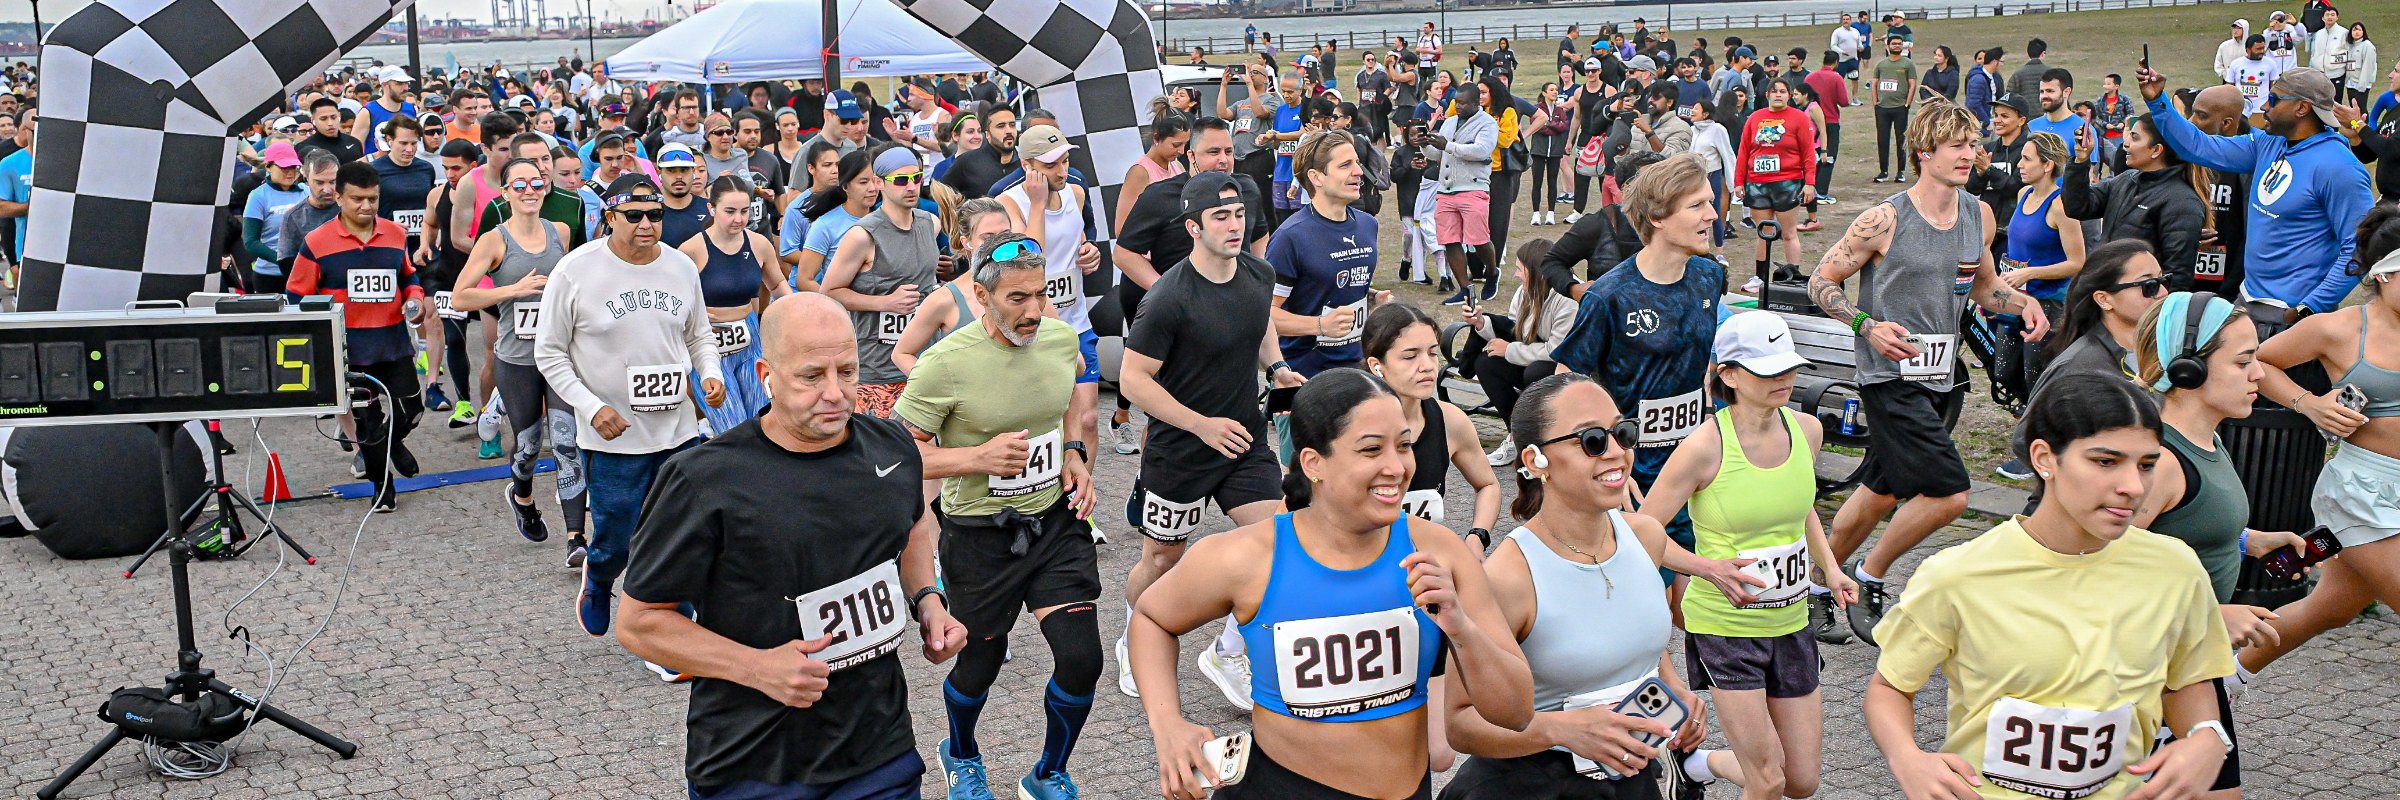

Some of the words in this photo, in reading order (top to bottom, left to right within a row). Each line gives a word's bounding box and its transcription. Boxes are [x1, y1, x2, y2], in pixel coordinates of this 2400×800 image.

[1755, 159, 1777, 171] 3451
[1351, 266, 1369, 274] NEW
[2196, 254, 2220, 273] 55
[354, 276, 391, 292] 2130
[1047, 276, 1073, 299] 391
[1351, 273, 1371, 281] YORK
[606, 289, 684, 319] LUCKY
[1769, 303, 1793, 311] PELICAN
[518, 308, 540, 328] 77
[884, 313, 916, 334] 20
[1970, 323, 1995, 355] LECTRIC
[277, 338, 311, 391] 5
[633, 372, 682, 398] 2227
[0, 404, 48, 415] hronomix
[633, 404, 667, 412] TRISTATE
[1643, 399, 1699, 434] 2388
[993, 487, 1034, 496] TRISTATE
[1035, 479, 1059, 492] TIMING
[1147, 502, 1201, 529] 2370
[818, 579, 896, 648] 2118
[828, 649, 877, 672] RISTATE
[1293, 626, 1403, 689] 2021
[1292, 703, 1361, 718] TRISTATE
[1364, 688, 1411, 708] TIMING
[2002, 715, 2116, 774] 2153
[1991, 778, 2065, 799] TRISTATE
